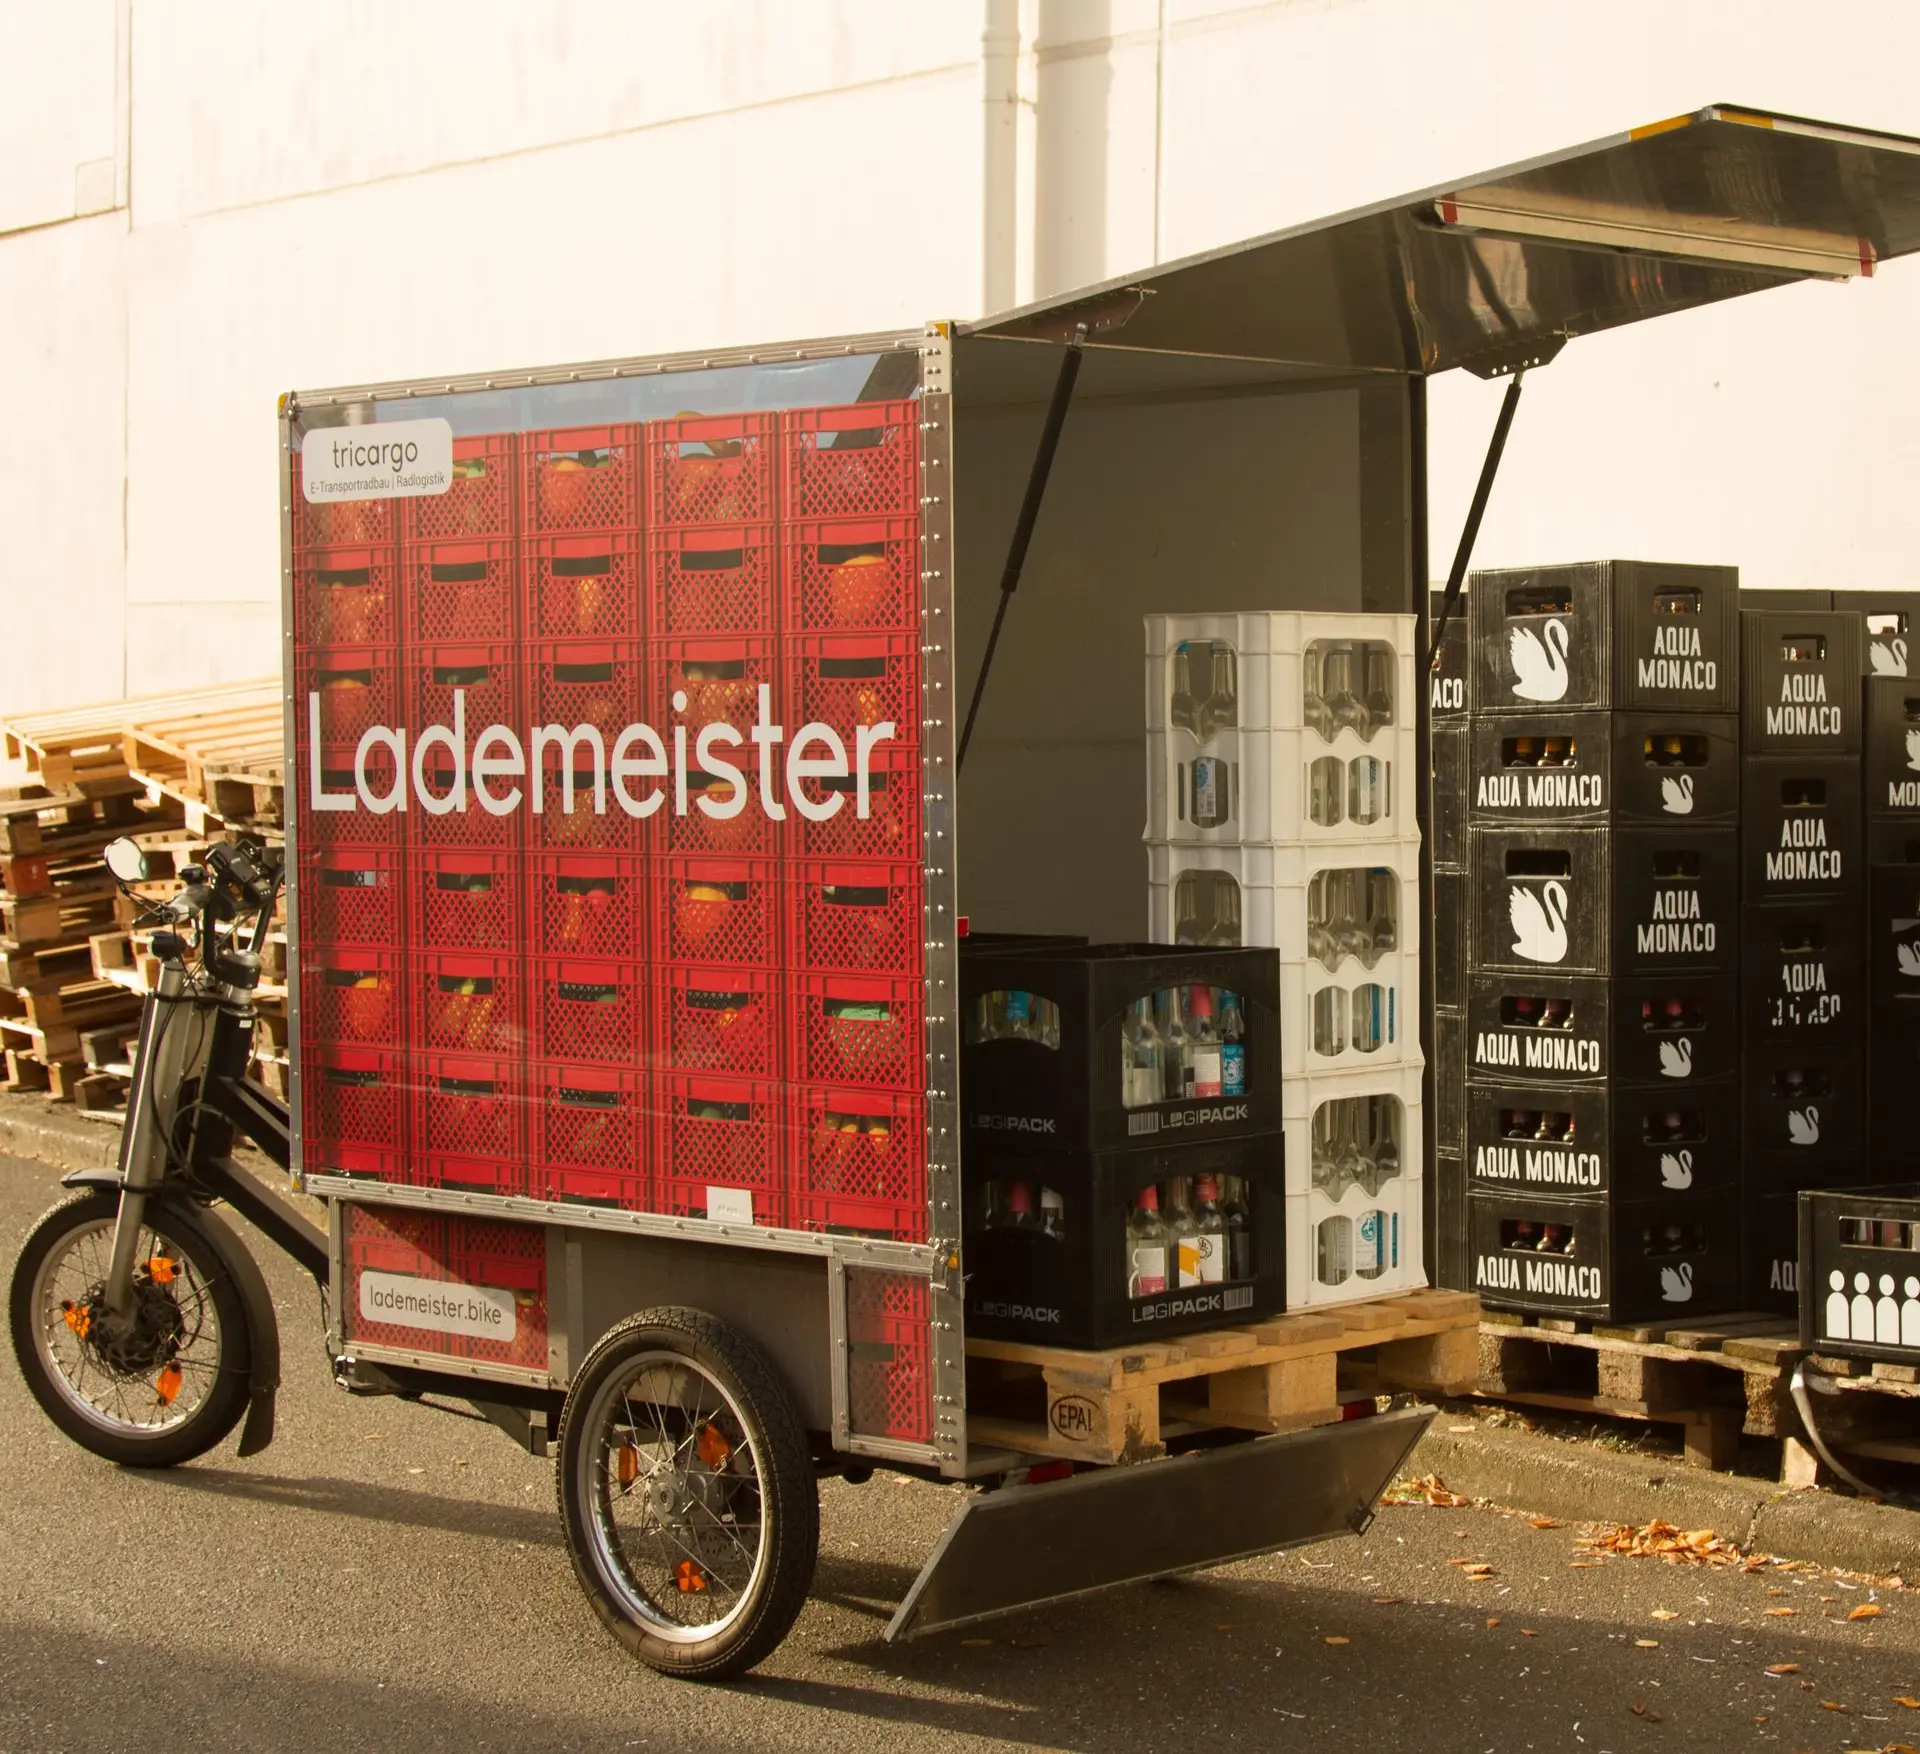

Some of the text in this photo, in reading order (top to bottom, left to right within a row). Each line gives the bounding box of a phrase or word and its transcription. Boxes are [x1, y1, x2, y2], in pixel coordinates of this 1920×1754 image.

[332, 440, 418, 473] tricargo
[310, 476, 390, 495] E-Transportradbau
[396, 470, 445, 489] Radlogistik
[1653, 626, 1702, 657] AQUA
[1638, 658, 1717, 691] MONACO
[1781, 673, 1827, 703] AQUA
[1766, 706, 1842, 735] MONACO
[309, 683, 896, 822] Lademeister
[1477, 774, 1602, 807] AQUA MONACO
[1780, 818, 1827, 848] AQUA
[1766, 850, 1842, 881] MONACO
[1652, 890, 1701, 920] AQUA
[1637, 923, 1717, 954] MONACO
[1781, 963, 1827, 993] AQUA
[1475, 1032, 1600, 1073] AQUA MONACO
[1160, 1104, 1248, 1130] LOGIPACK
[1475, 1145, 1601, 1186] AQUA MONACO
[1476, 1254, 1602, 1300] AQUA MONACO
[369, 1285, 502, 1325] lademeister.bike
[1132, 1294, 1221, 1324] LOGIPACK
